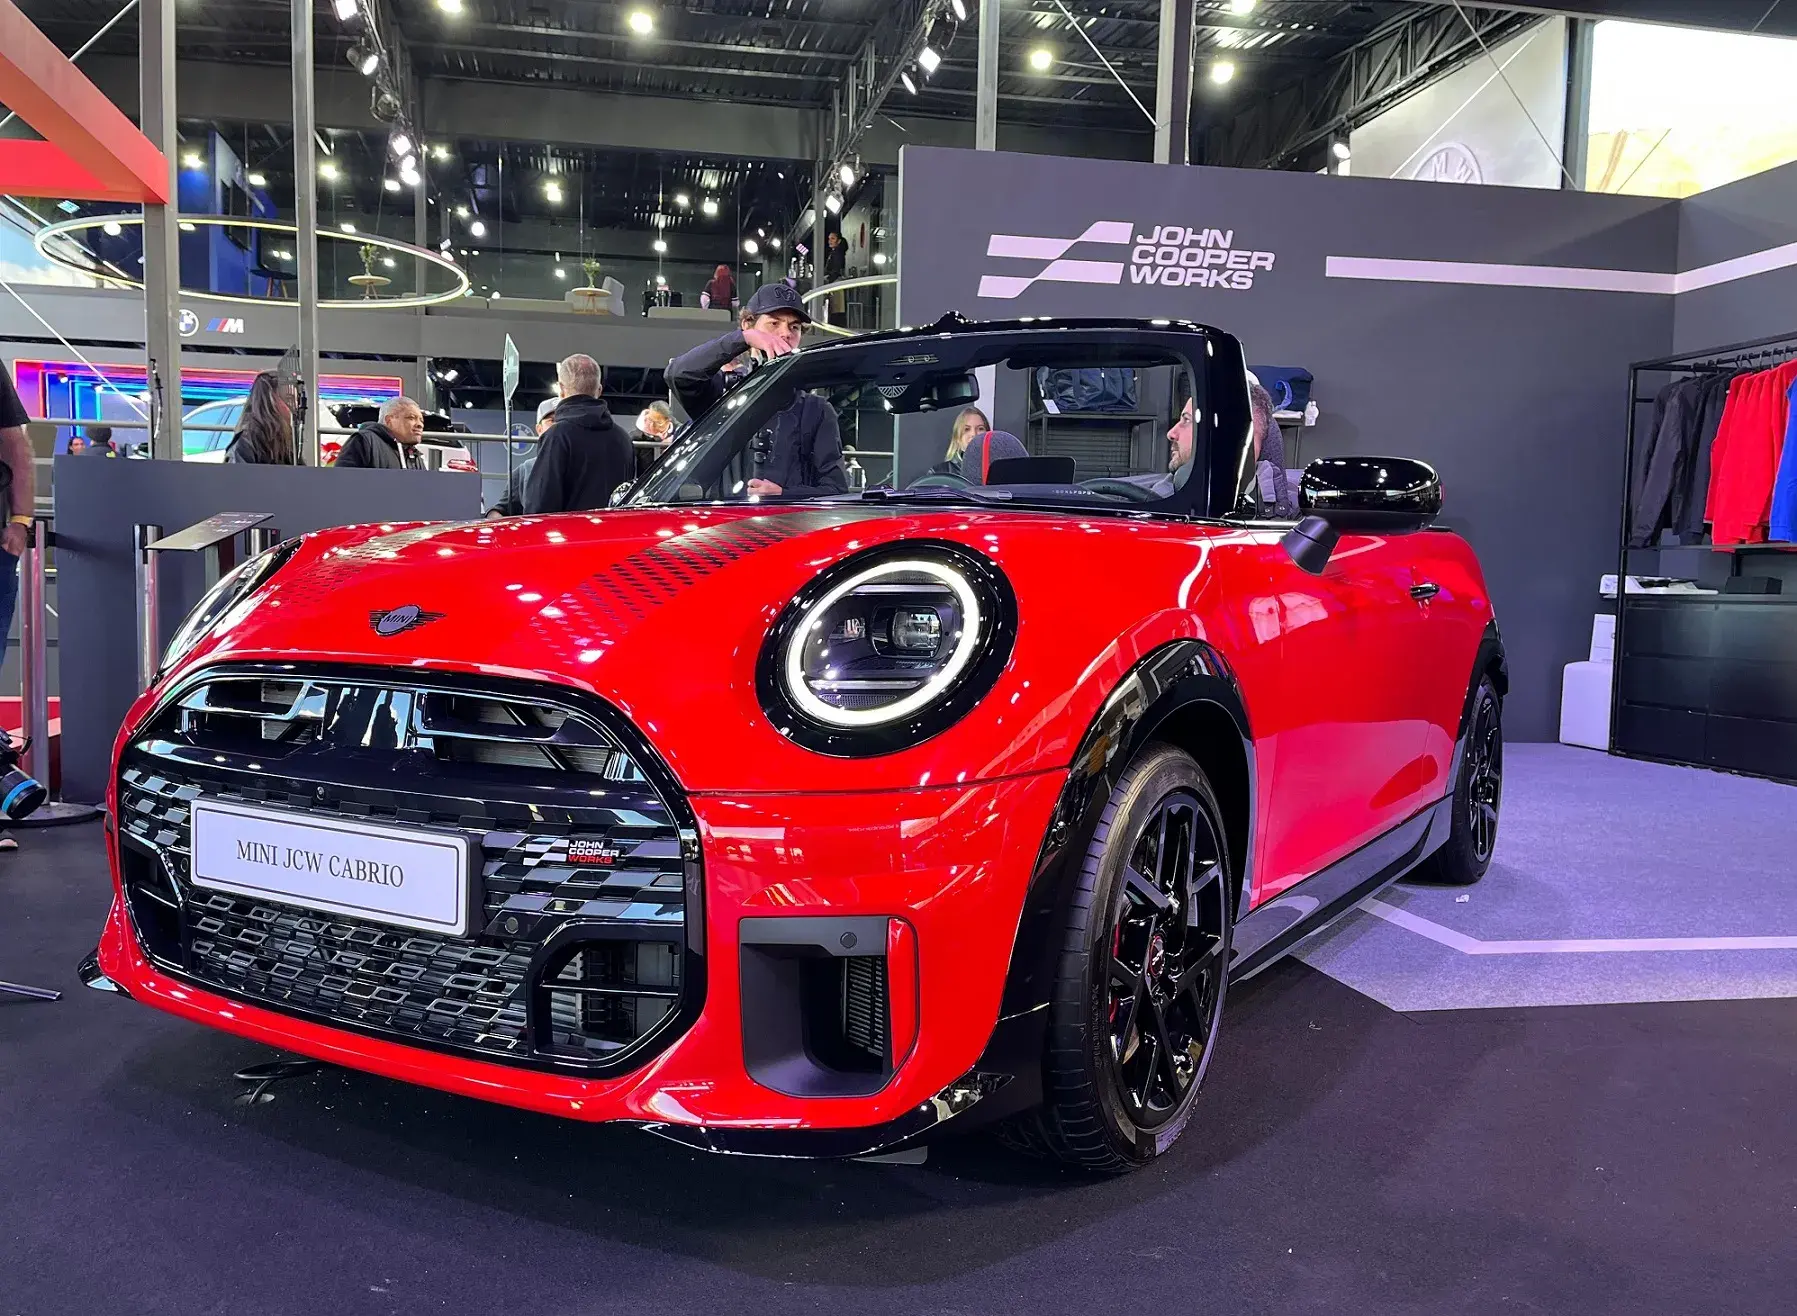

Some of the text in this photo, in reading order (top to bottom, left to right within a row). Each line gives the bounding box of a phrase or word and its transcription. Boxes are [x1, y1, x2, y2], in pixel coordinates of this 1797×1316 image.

[1136, 225, 1234, 248] JOHN
[1131, 245, 1276, 271] COOPER
[1129, 265, 1254, 290] WORKS
[221, 317, 245, 333] M
[381, 614, 414, 623] MINI
[568, 847, 620, 857] COOPER
[569, 840, 604, 849] JOHN
[236, 839, 404, 888] MINI JCW CABRIO
[568, 854, 613, 864] WORKS
